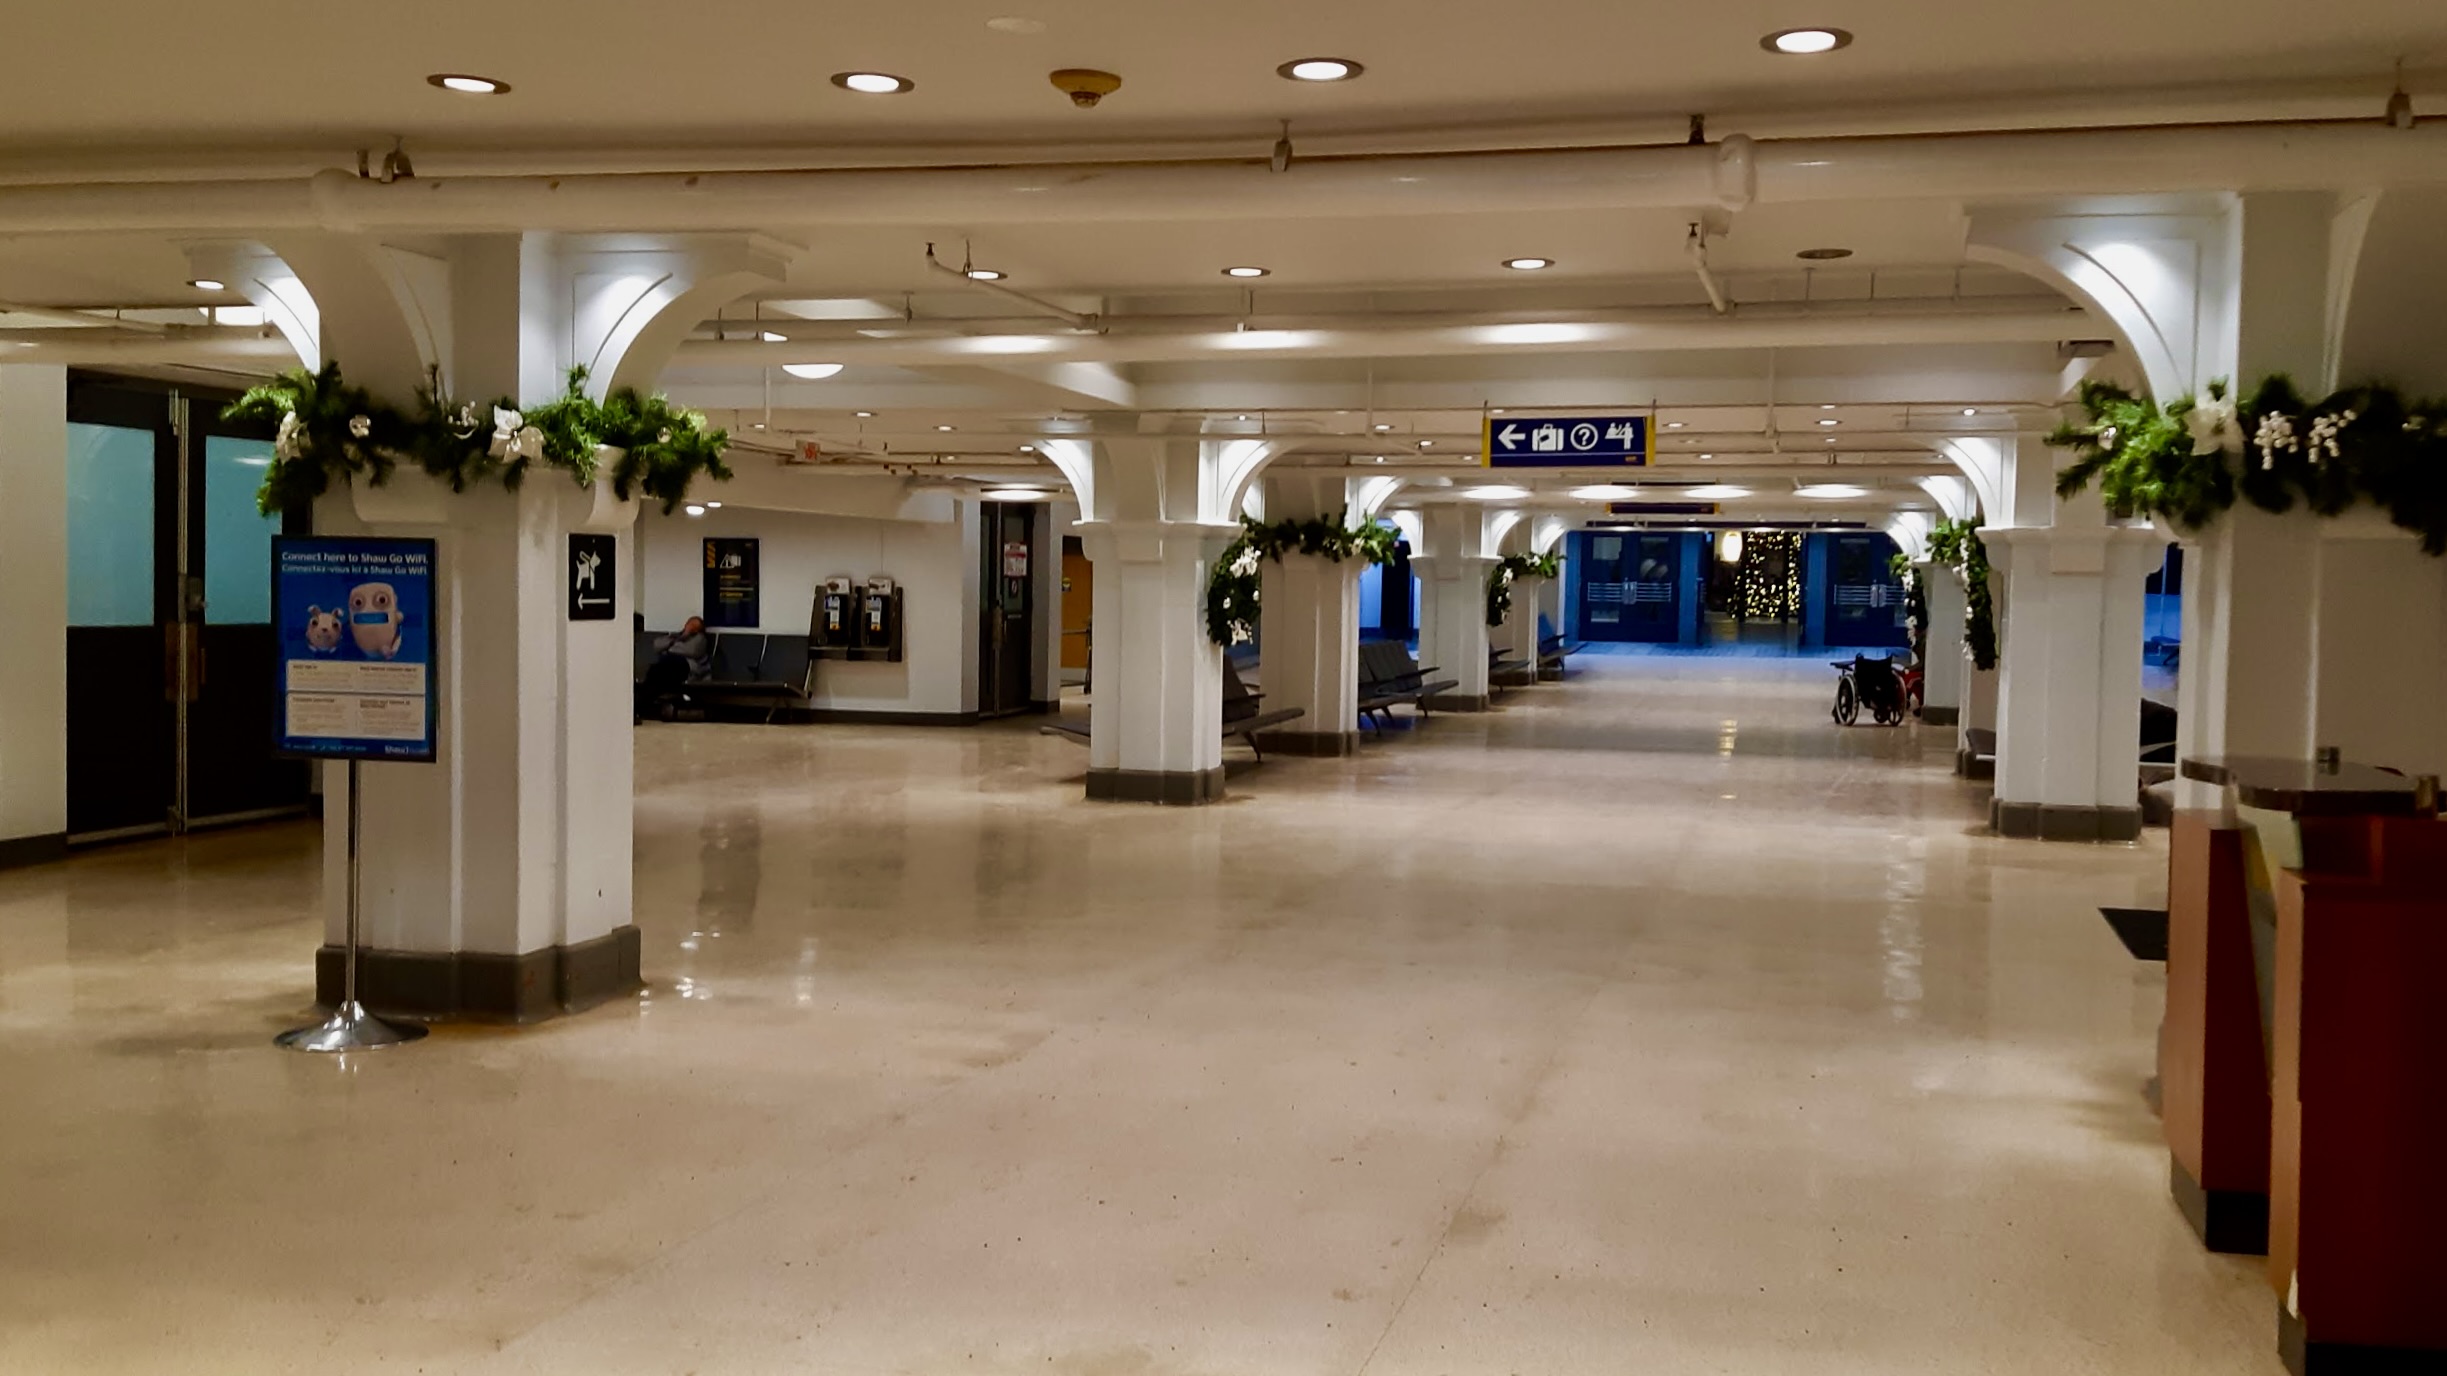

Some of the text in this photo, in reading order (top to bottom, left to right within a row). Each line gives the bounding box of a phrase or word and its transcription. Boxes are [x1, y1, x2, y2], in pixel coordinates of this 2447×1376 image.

[282, 552, 321, 562] Connect
[324, 552, 346, 562] here
[348, 554, 358, 562] to
[361, 553, 387, 563] Shaw
[389, 554, 402, 563] Go
[370, 566, 392, 574] Shaw
[394, 566, 406, 574] Go
